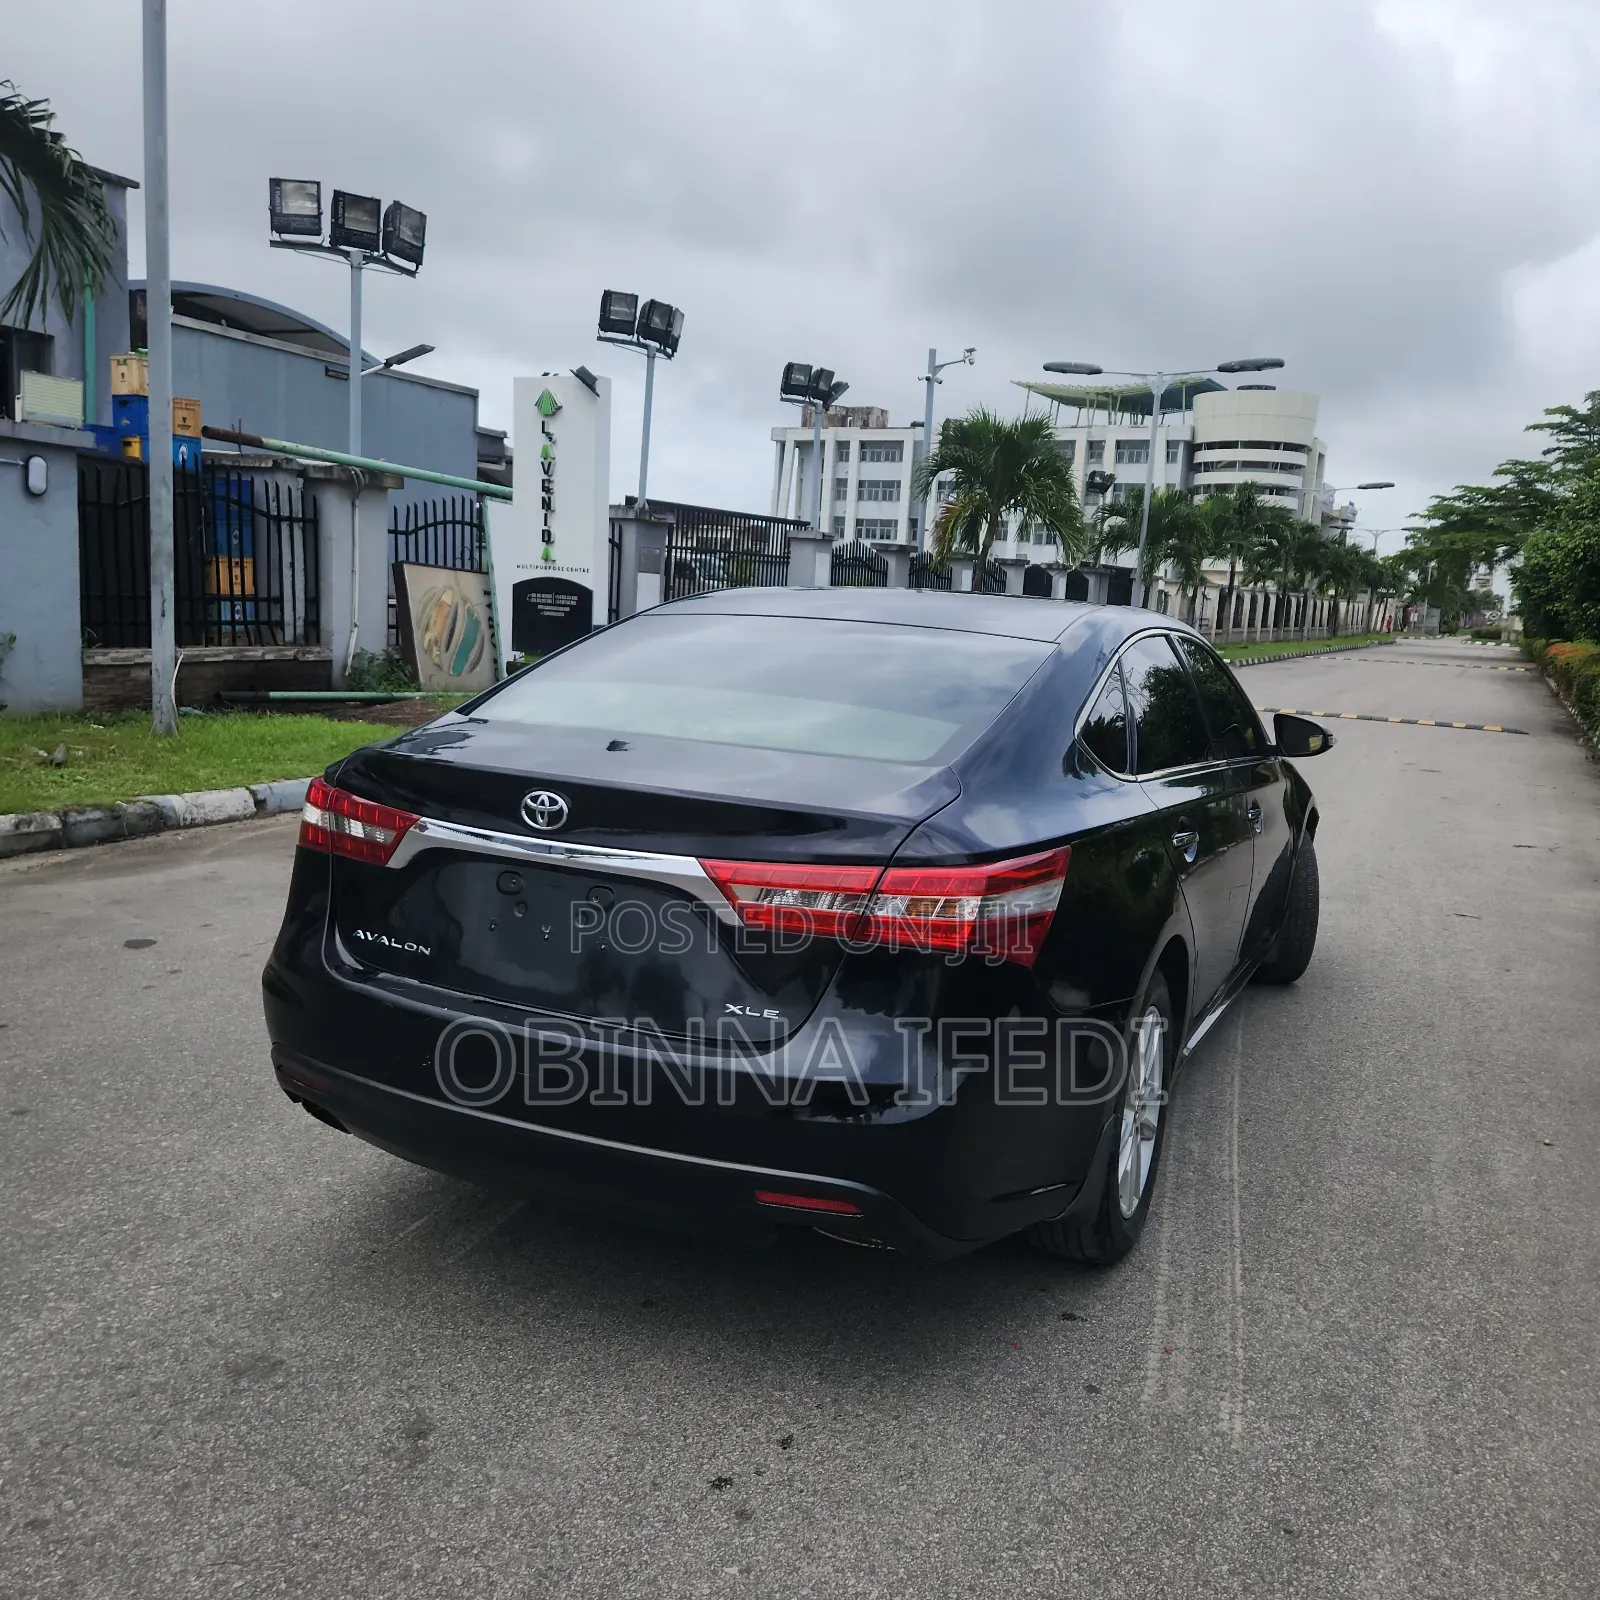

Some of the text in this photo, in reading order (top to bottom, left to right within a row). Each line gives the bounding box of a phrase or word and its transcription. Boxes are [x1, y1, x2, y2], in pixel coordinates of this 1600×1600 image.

[516, 564, 590, 574] MULTIPURPOSE CENTRE
[352, 929, 431, 955] AVALON
[724, 1003, 780, 1019] XLE
